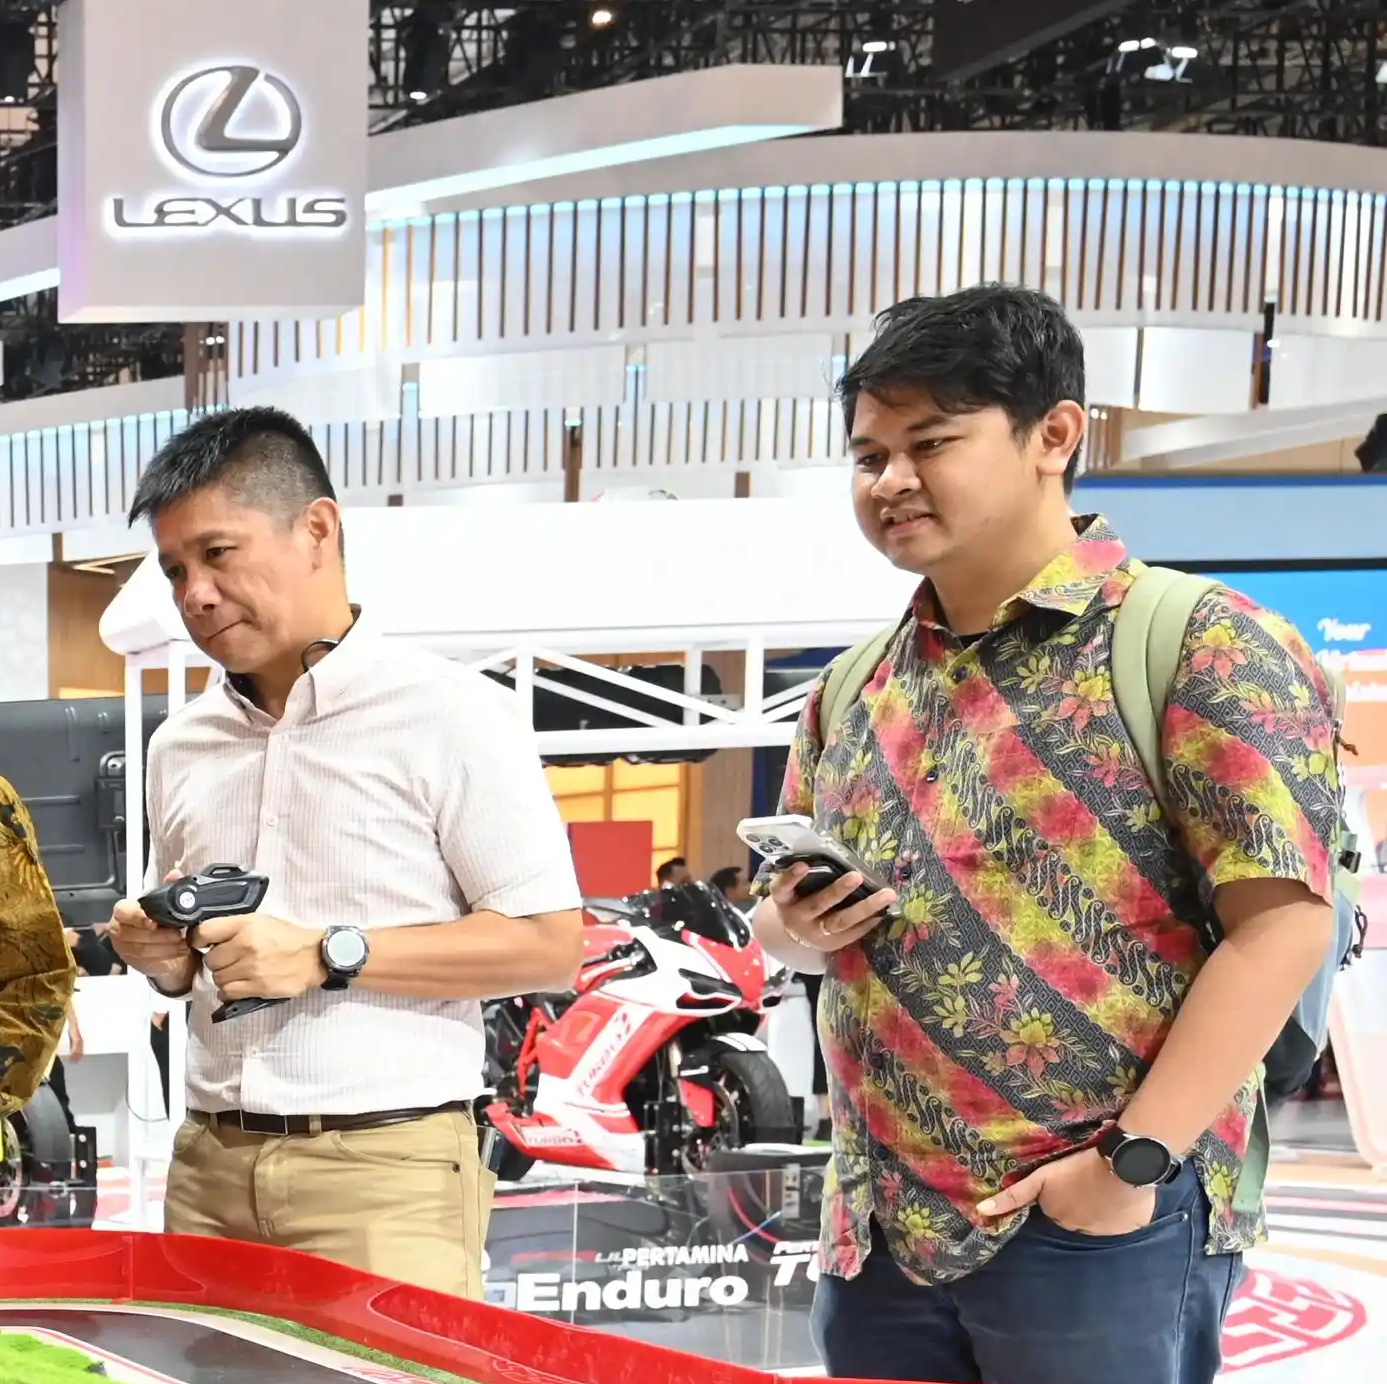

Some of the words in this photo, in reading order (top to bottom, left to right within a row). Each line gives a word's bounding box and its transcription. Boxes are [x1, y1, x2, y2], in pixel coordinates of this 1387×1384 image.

[113, 197, 348, 228] LEXUS
[1317, 617, 1372, 642] Your
[623, 1243, 749, 1266] PERTAMINA
[516, 1269, 749, 1312] Enduro
